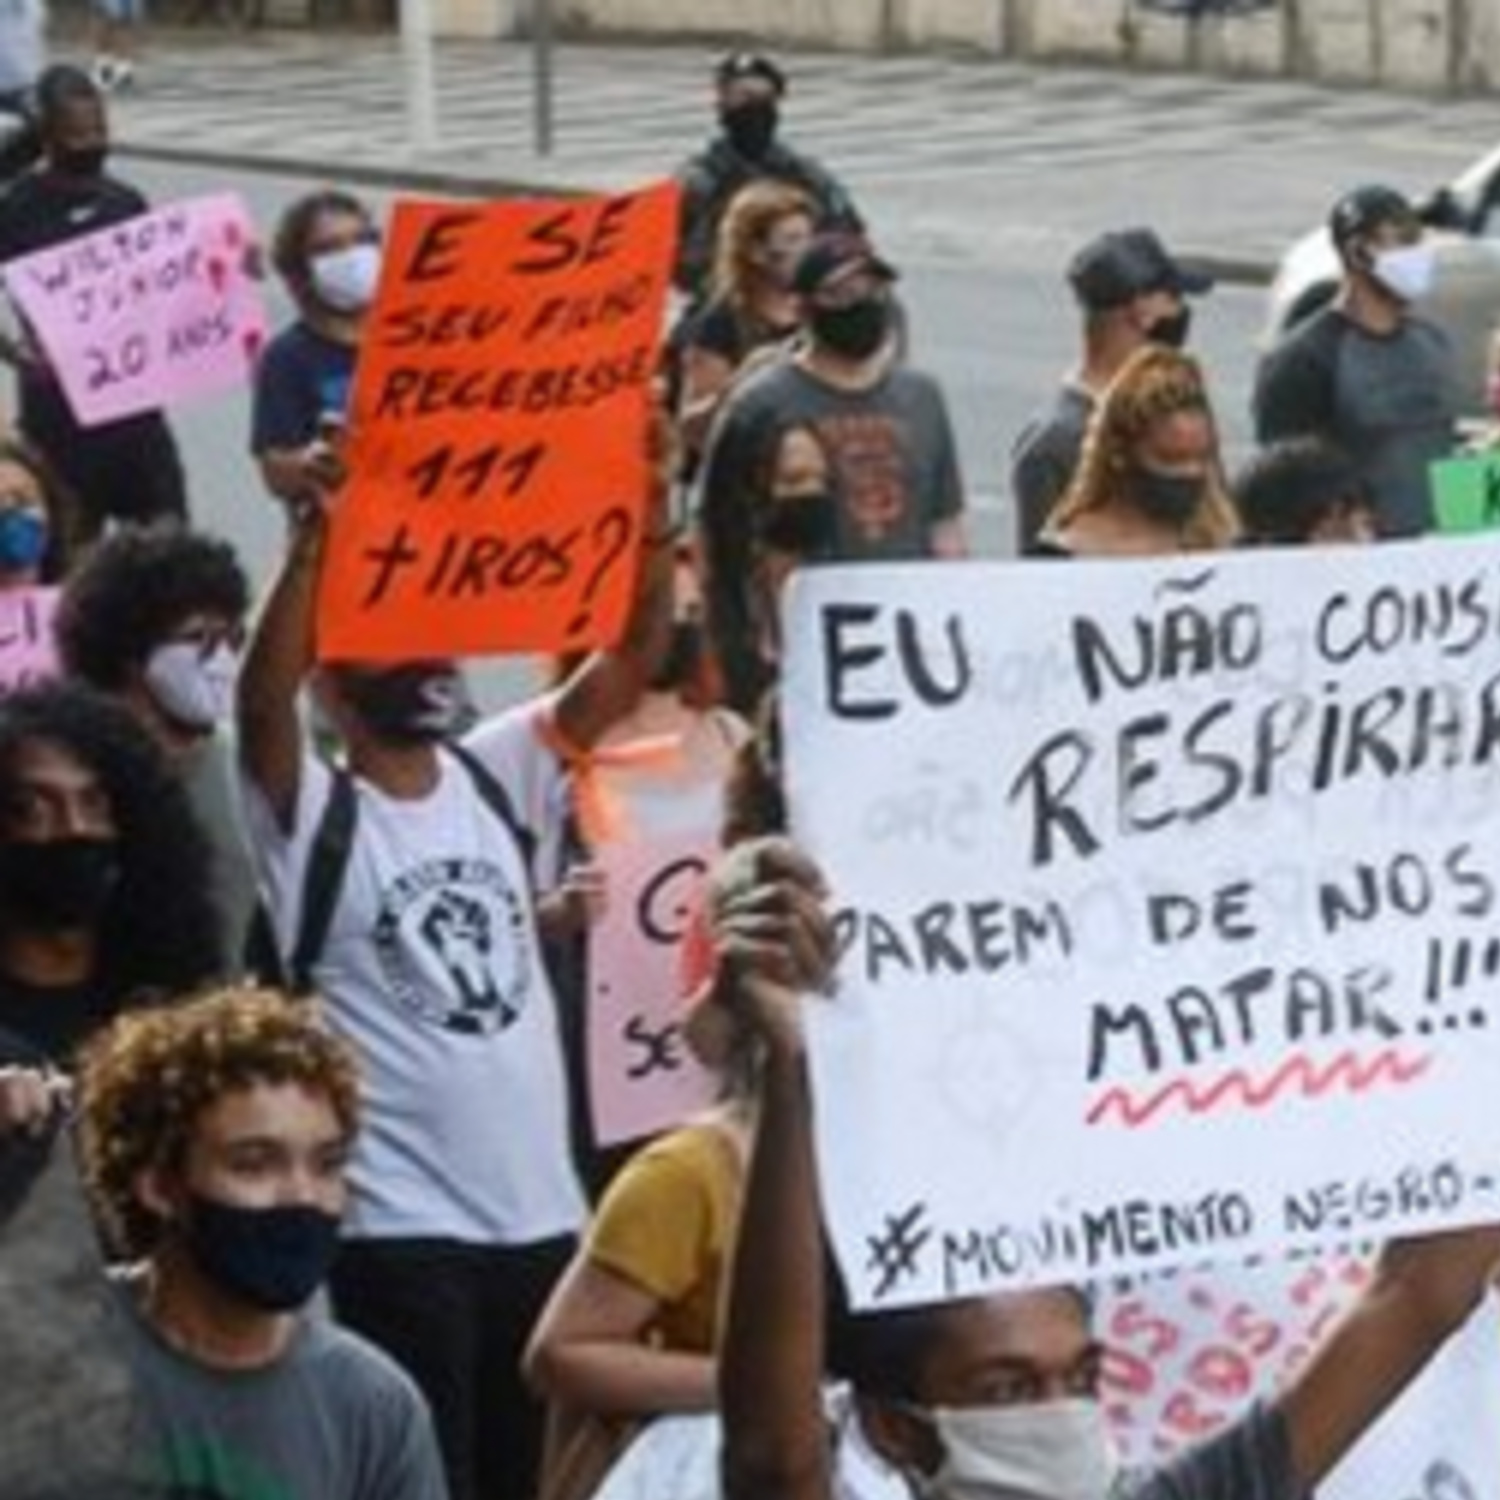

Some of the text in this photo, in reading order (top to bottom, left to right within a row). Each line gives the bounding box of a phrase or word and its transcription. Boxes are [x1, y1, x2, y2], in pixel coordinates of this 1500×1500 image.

[403, 194, 638, 284] E SE
[380, 300, 511, 347] SEU
[84, 332, 147, 392] 20
[406, 443, 548, 500] 111
[821, 602, 972, 718] EU
[1068, 569, 1265, 702] NÃO
[832, 843, 1496, 982] PAREM DE NOS
